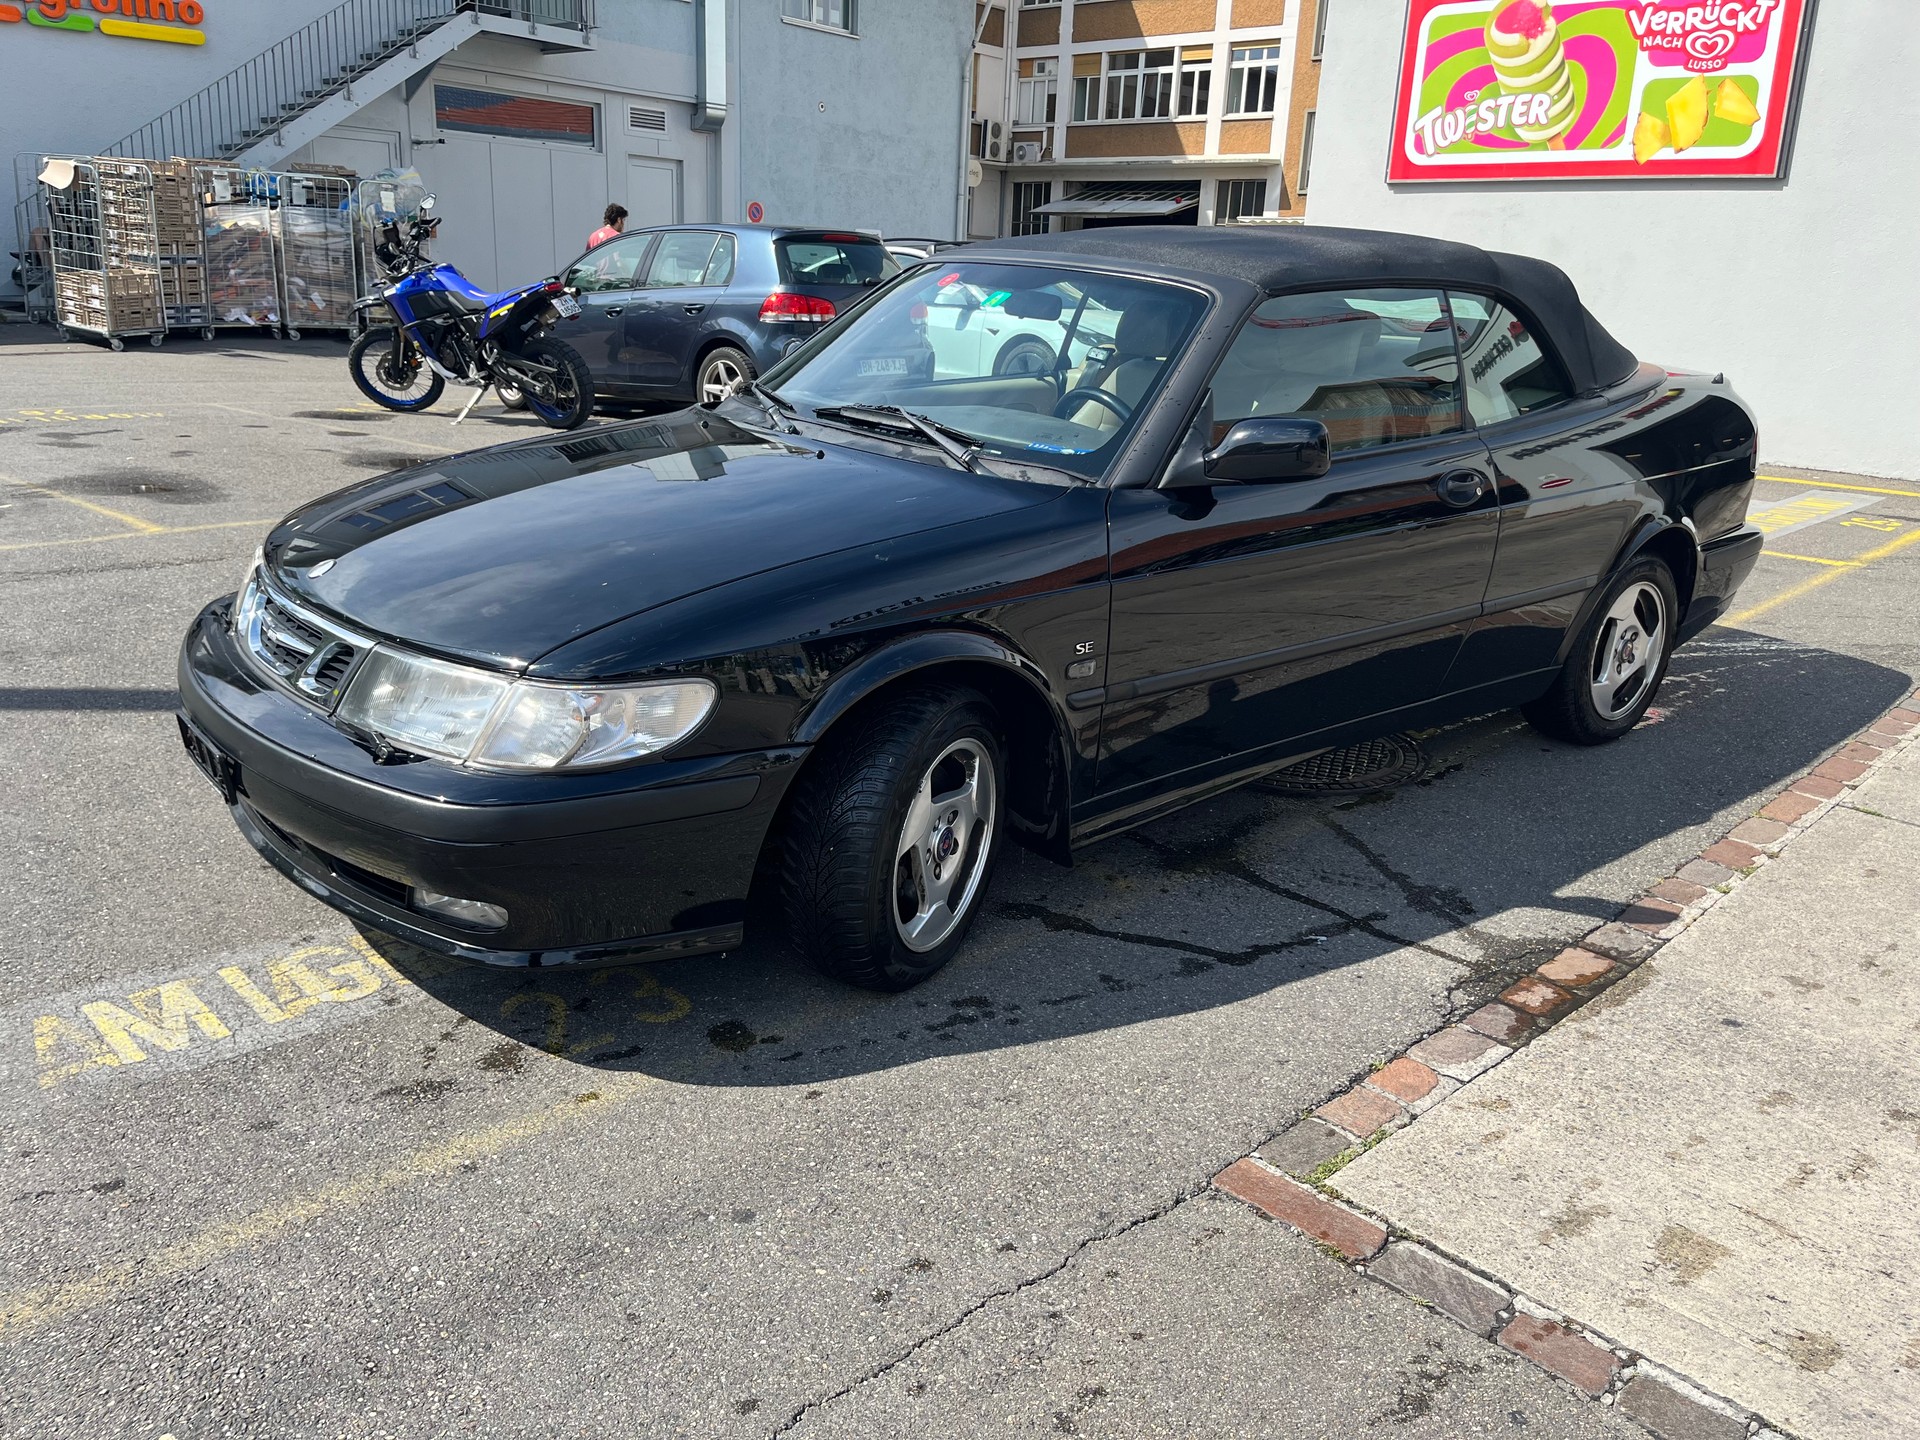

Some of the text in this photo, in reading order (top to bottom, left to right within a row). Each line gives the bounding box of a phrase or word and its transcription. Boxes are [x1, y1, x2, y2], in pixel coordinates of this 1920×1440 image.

[1643, 35, 1683, 48] NACH
[1688, 58, 1722, 70] LUSSO
[1414, 93, 1552, 156] TWISTER
[558, 296, 569, 306] ZH
[1075, 641, 1094, 655] SE
